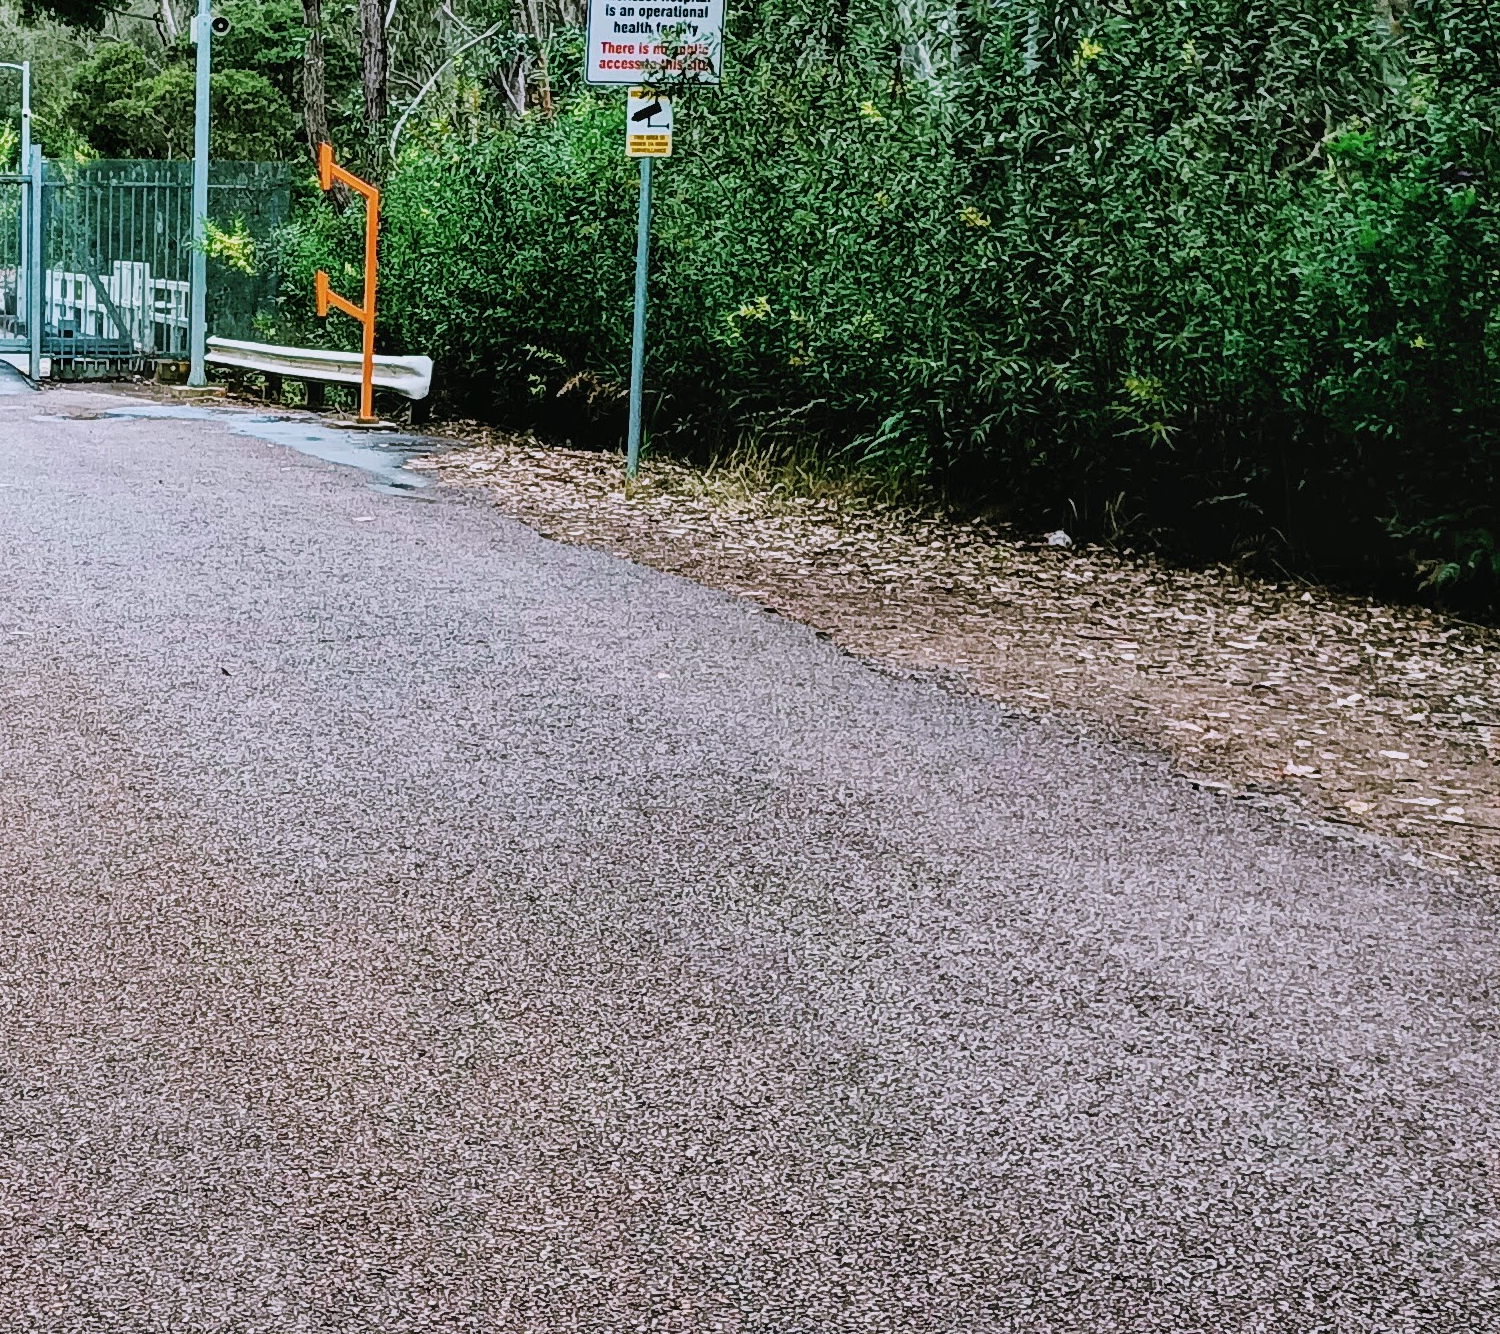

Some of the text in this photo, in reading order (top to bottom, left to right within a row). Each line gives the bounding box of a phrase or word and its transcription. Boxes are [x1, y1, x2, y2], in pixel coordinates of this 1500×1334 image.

[605, 3, 709, 20] is an operational
[613, 21, 652, 34] health
[600, 41, 635, 55] There
[638, 42, 649, 55] is
[673, 43, 709, 56] ublic
[598, 58, 641, 70] access
